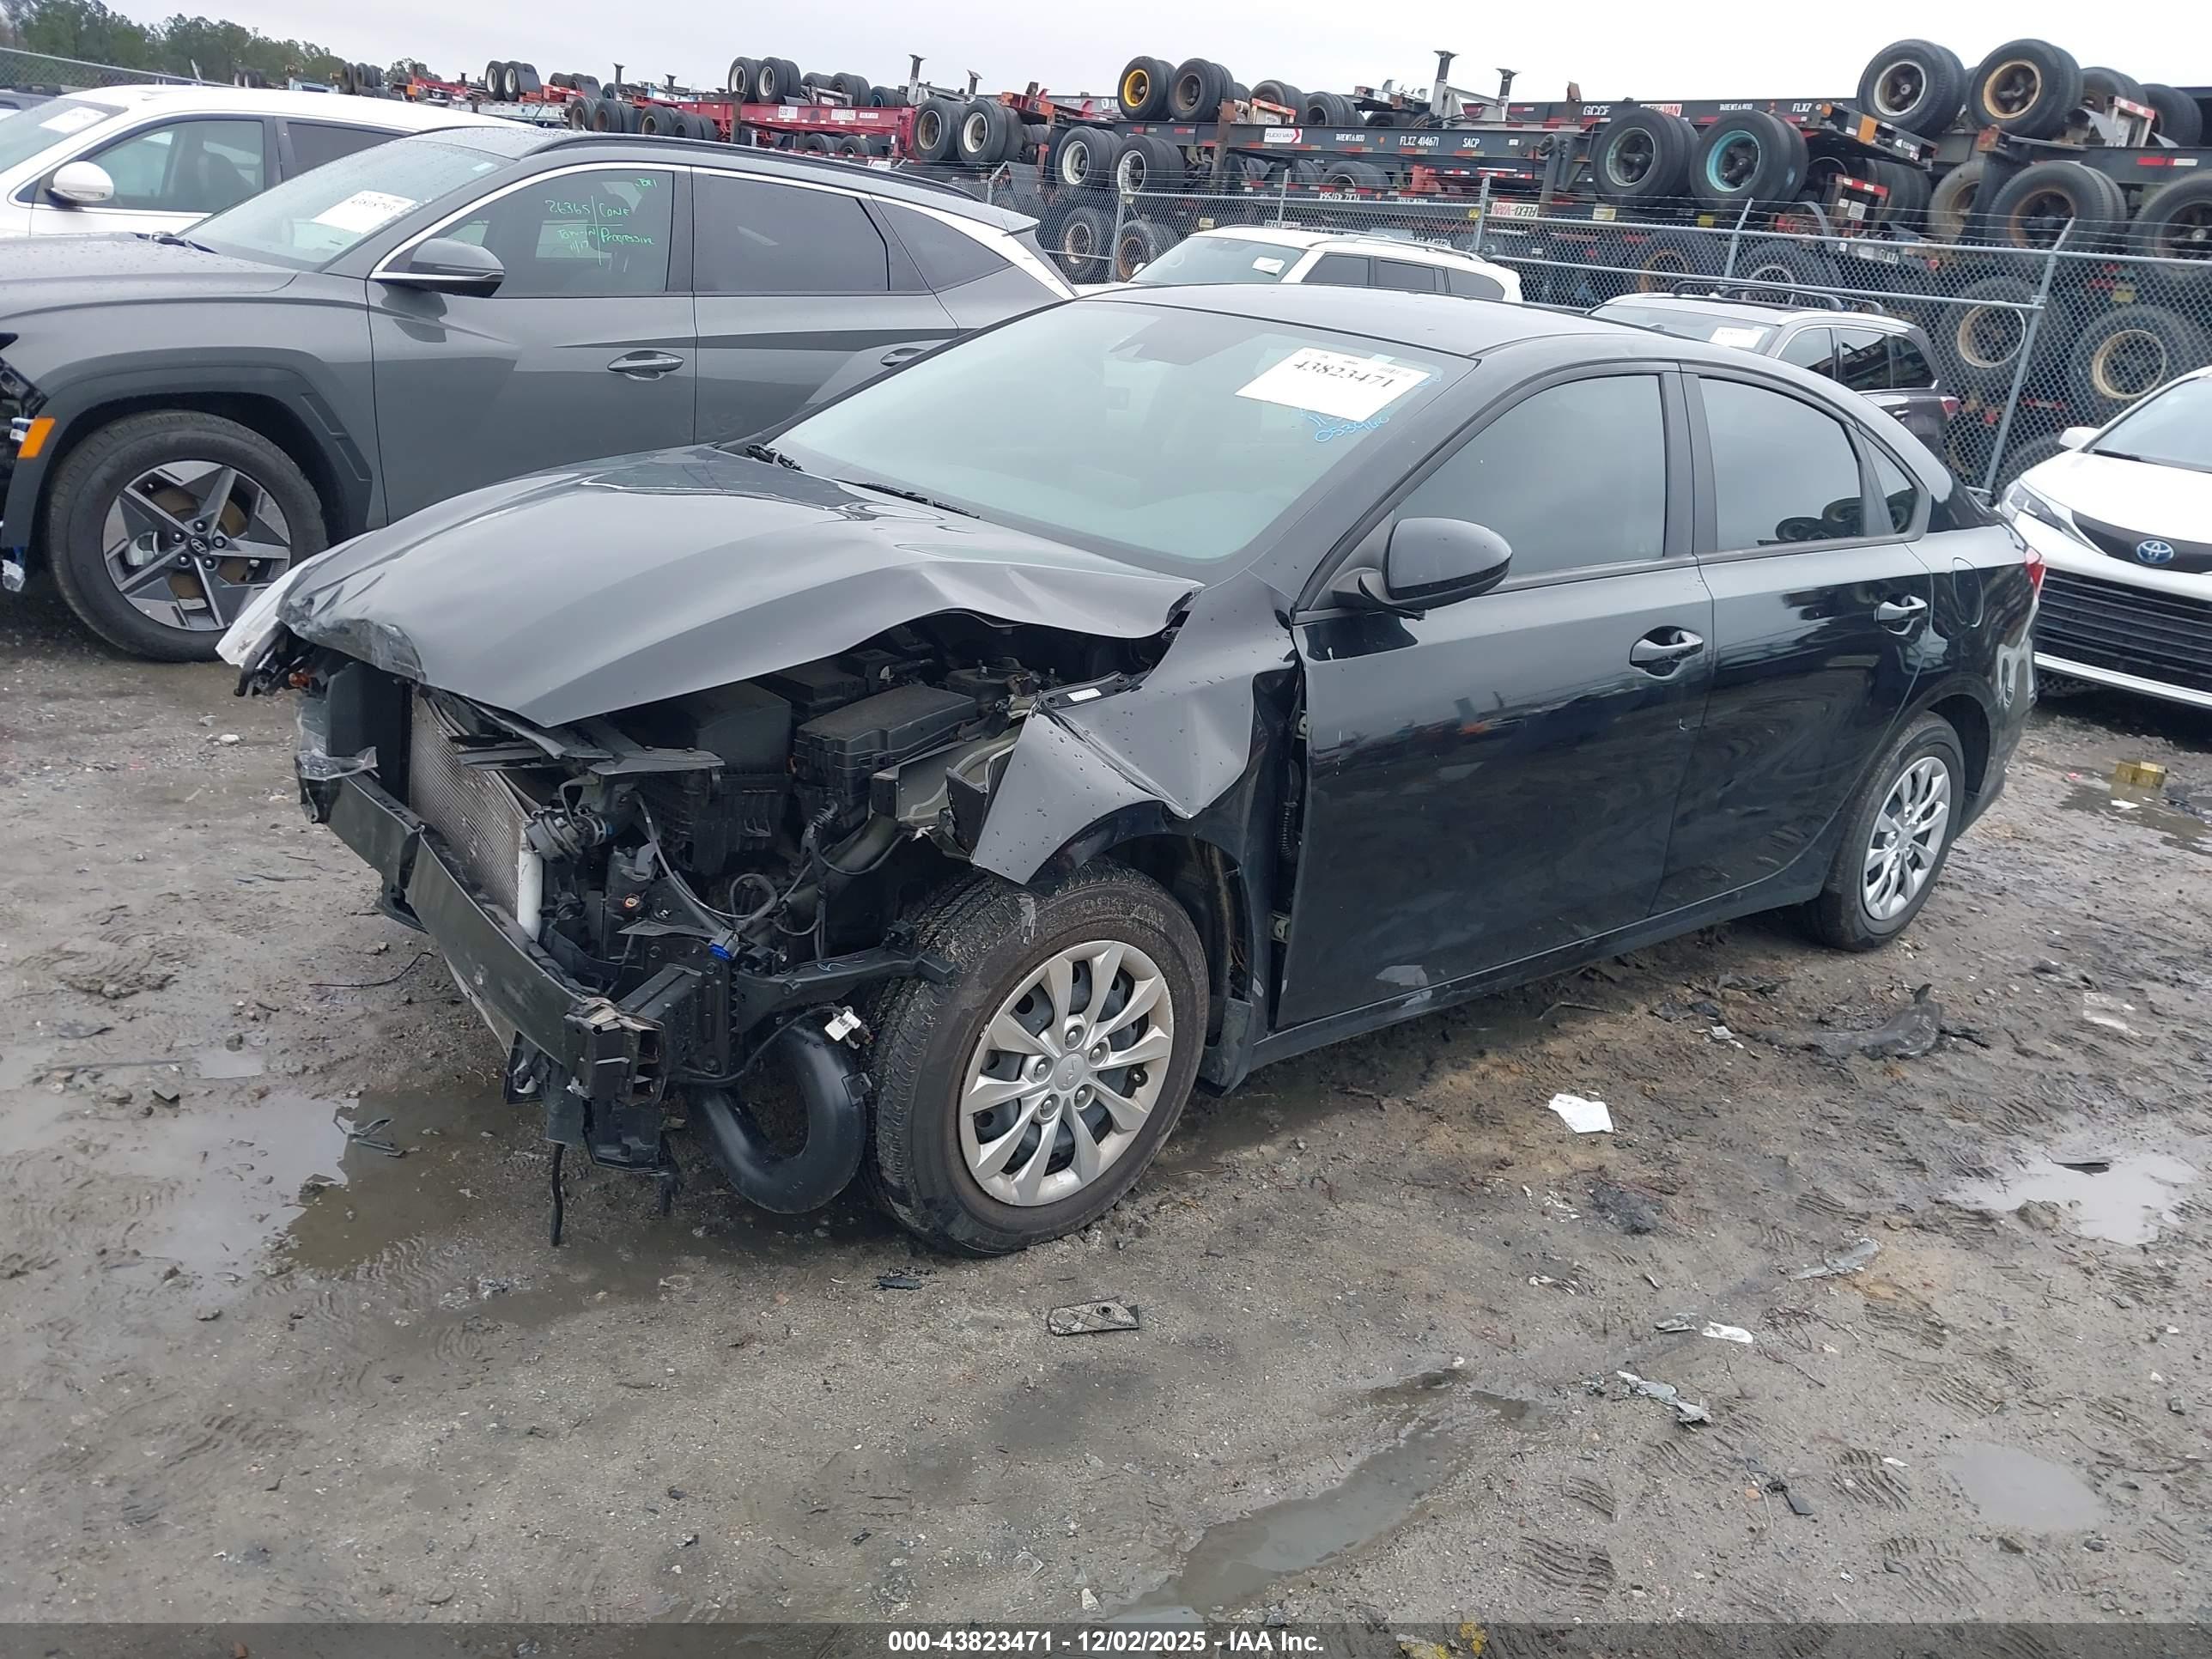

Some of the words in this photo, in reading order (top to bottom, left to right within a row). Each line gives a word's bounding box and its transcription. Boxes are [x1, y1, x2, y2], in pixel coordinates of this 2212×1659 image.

[1399, 136, 1417, 146] FLXZ
[1462, 137, 1480, 148] SACP
[544, 199, 591, 215] 26365
[1292, 361, 1395, 388] 43823471
